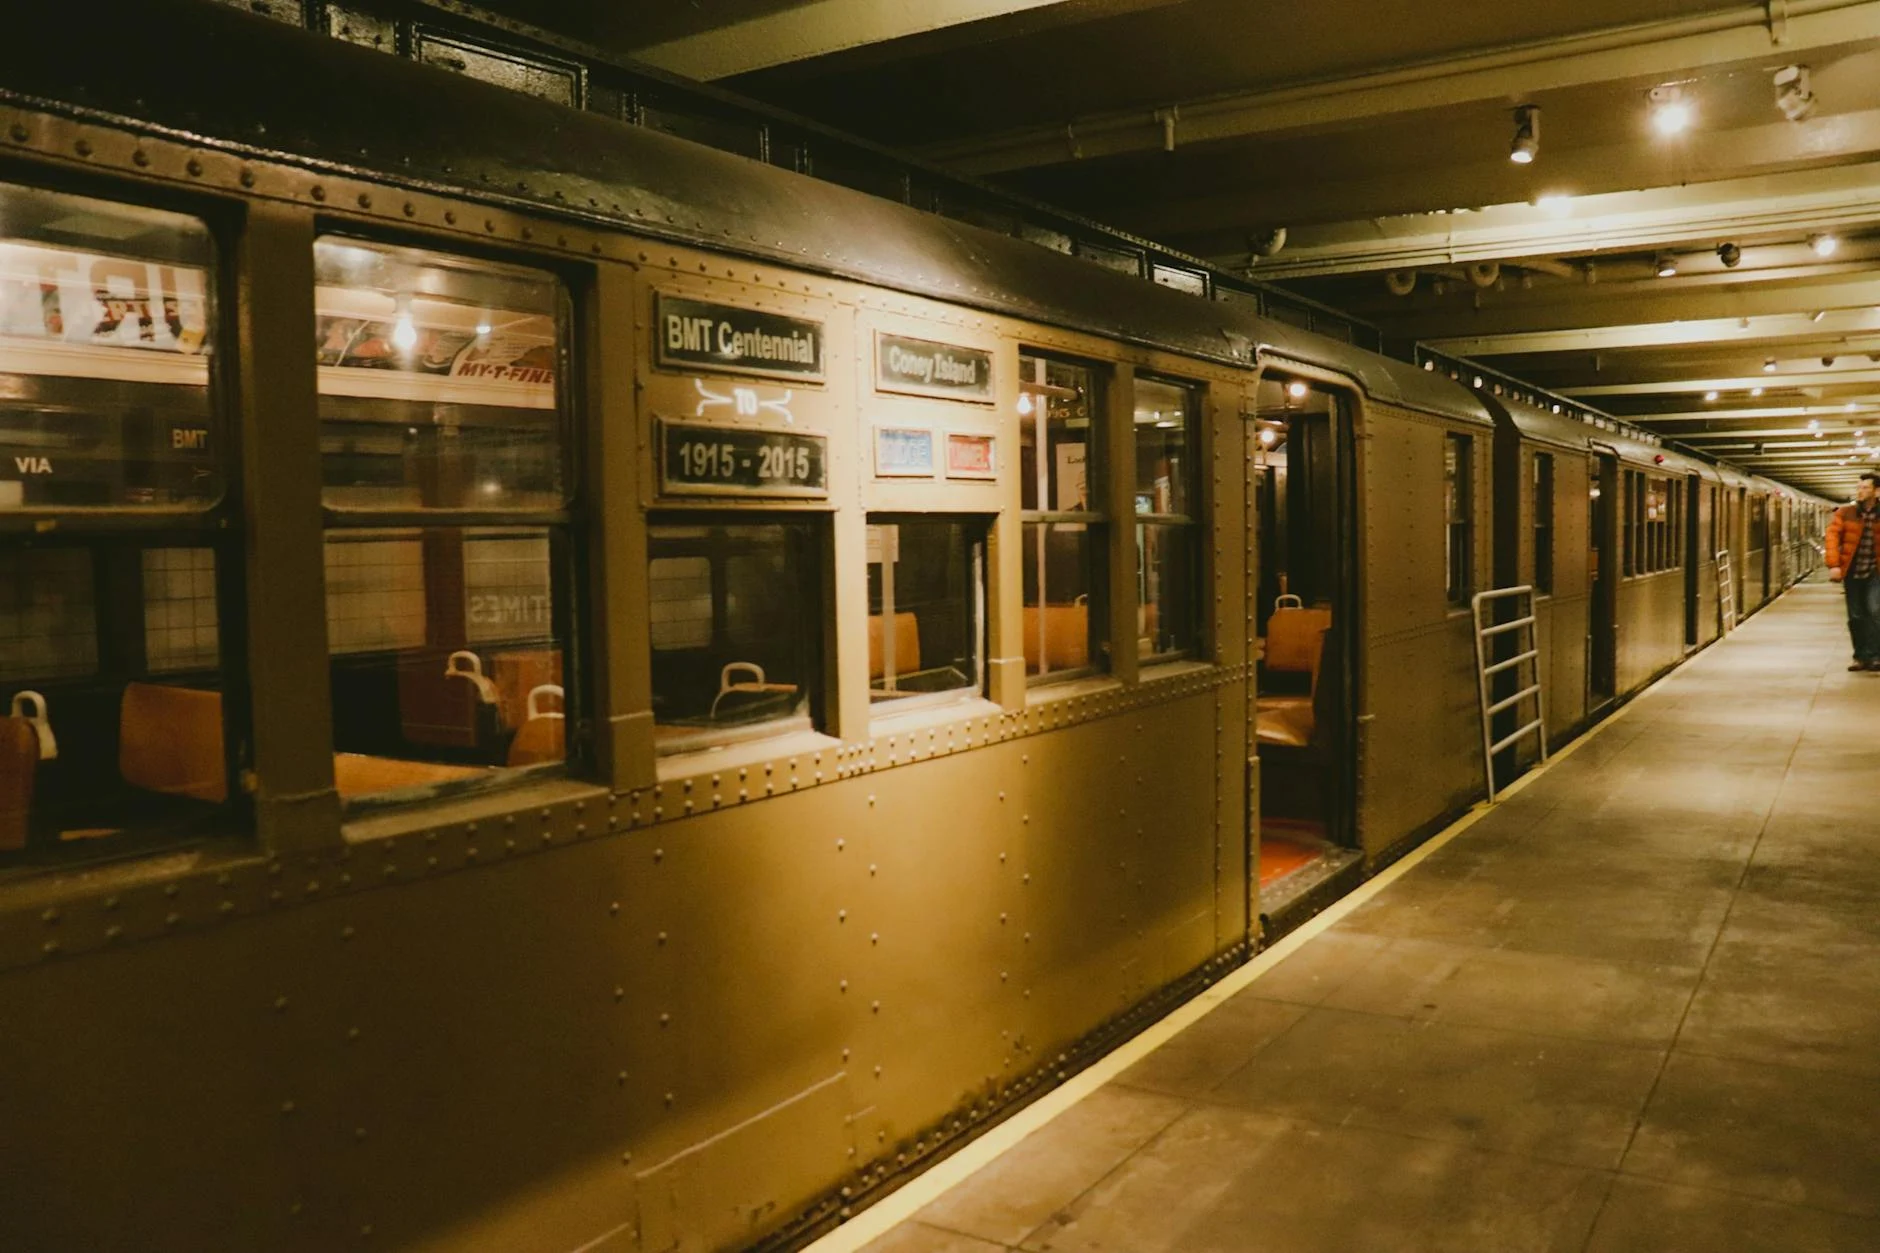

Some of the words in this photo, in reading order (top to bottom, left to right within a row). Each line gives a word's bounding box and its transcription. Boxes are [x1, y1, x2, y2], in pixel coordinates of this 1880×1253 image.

[667, 315, 712, 353] BMT
[718, 321, 815, 364] Centennial
[889, 345, 933, 383] Coney
[934, 353, 976, 384] Island
[172, 428, 208, 449] BMT
[15, 456, 53, 474] VIA
[679, 442, 734, 477] 1915
[742, 459, 751, 467] -
[757, 445, 810, 479] 2015
